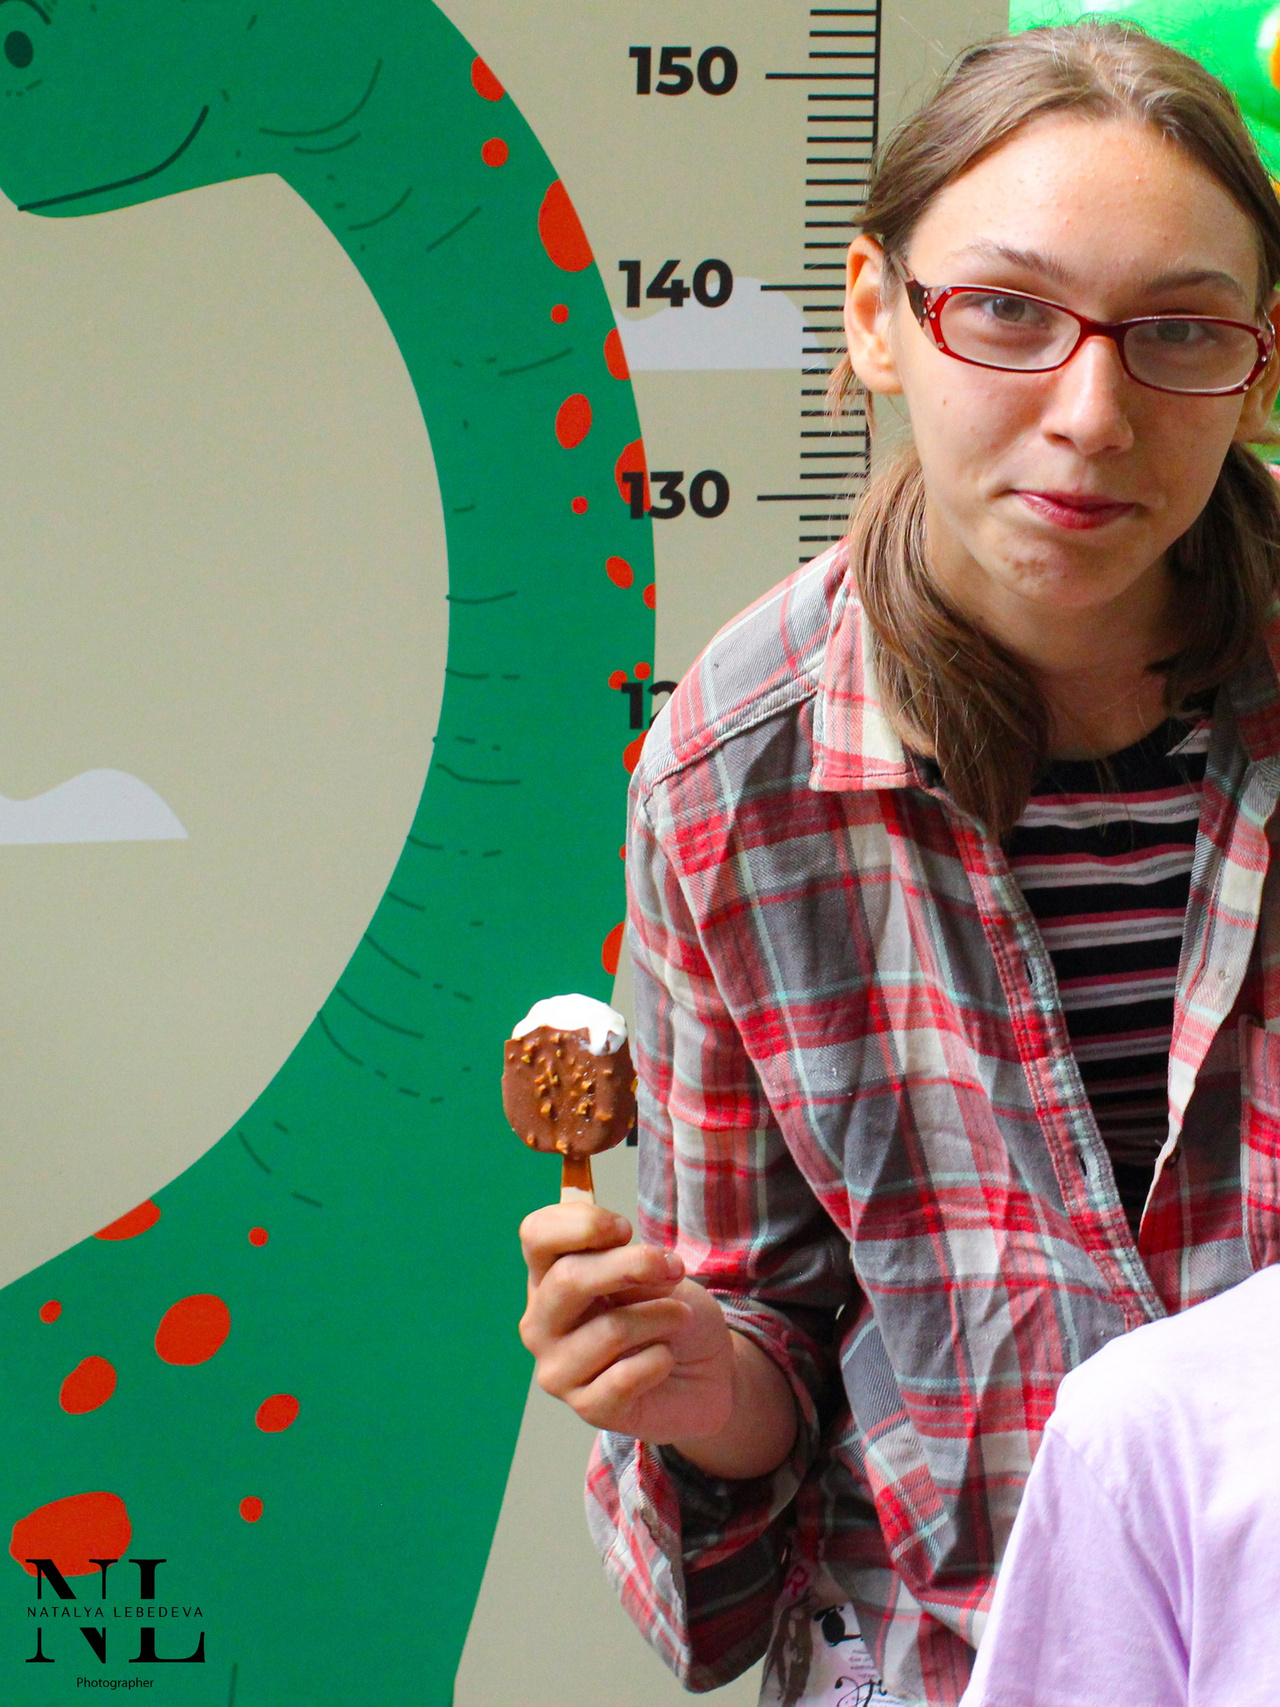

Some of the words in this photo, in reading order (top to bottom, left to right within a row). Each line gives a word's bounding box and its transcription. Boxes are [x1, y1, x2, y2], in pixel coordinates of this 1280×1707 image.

[629, 46, 738, 96] 150
[618, 259, 733, 309] 140
[622, 470, 730, 520] 130
[621, 681, 678, 730] 12
